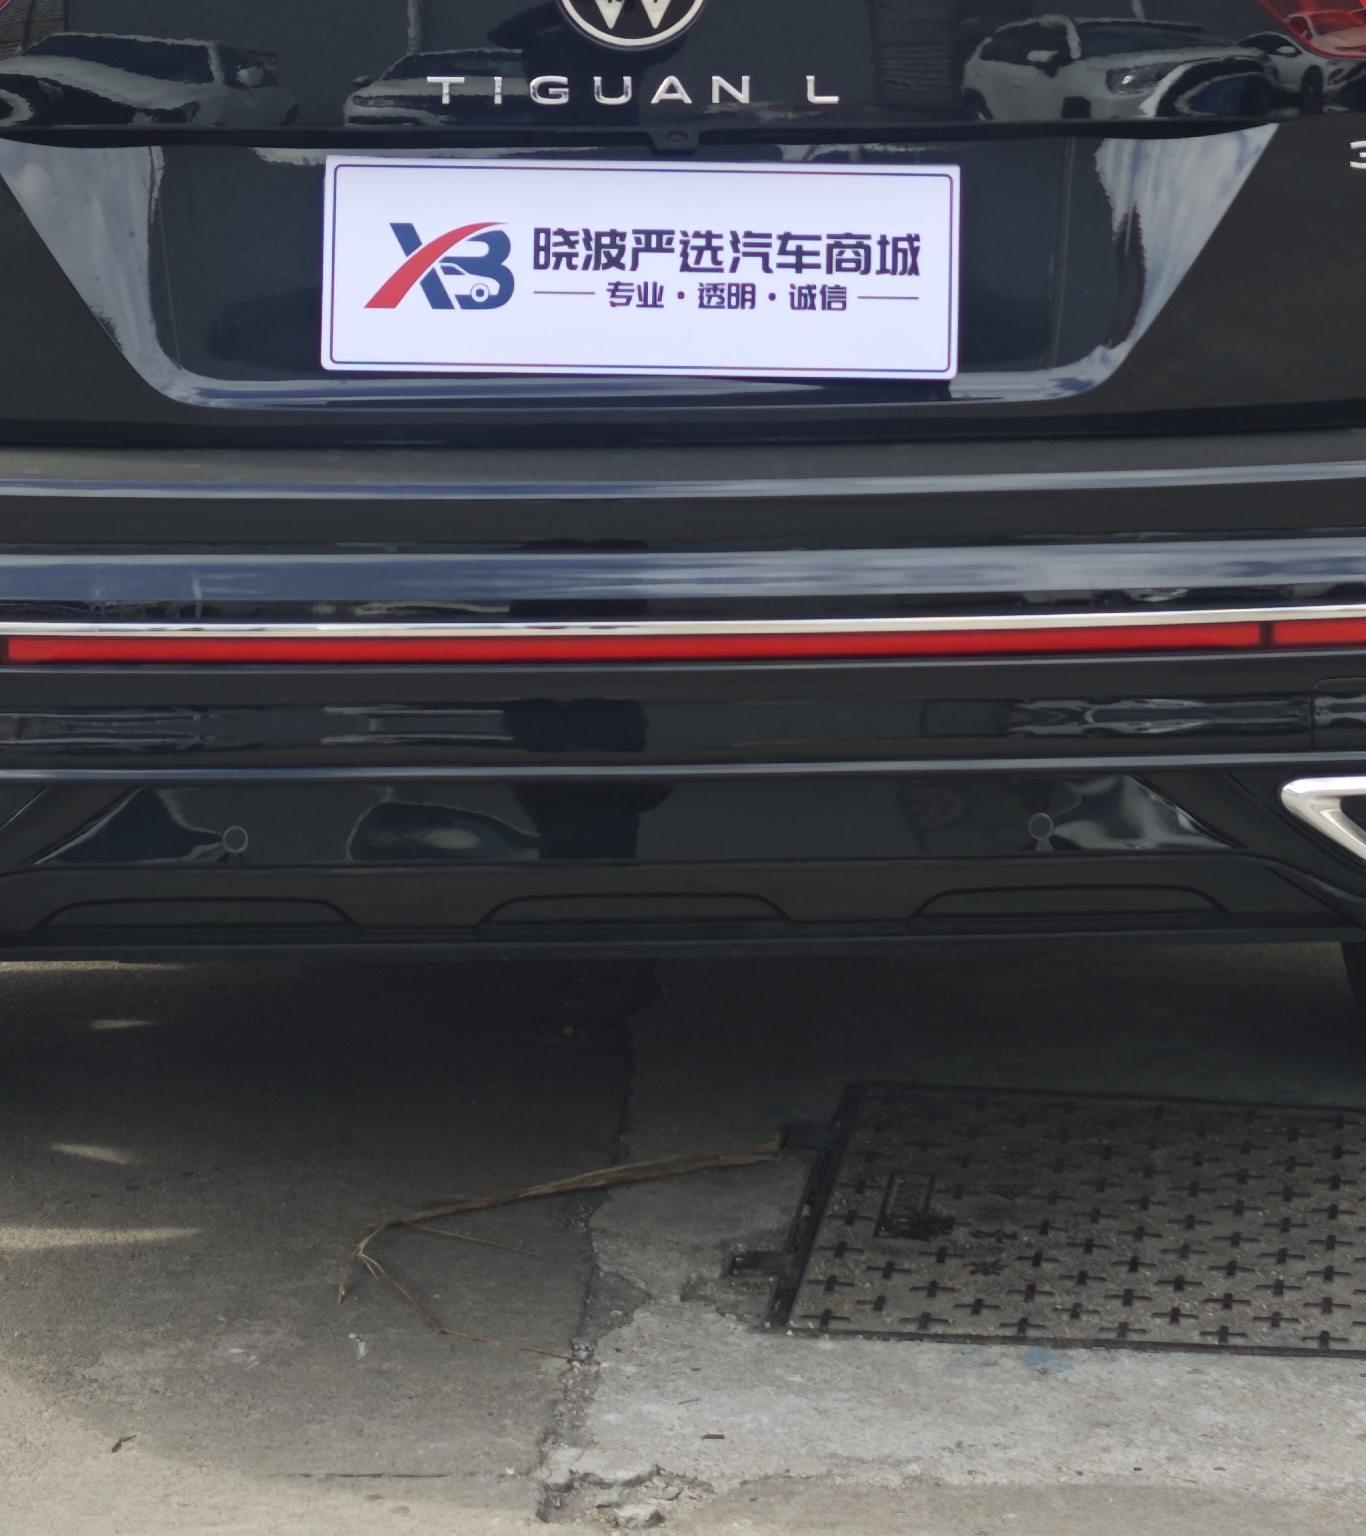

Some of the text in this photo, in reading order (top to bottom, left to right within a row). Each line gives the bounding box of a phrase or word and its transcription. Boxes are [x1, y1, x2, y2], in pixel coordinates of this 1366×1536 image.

[426, 75, 840, 105] TIGUAN L
[533, 227, 921, 276] 晓波严选汽车商城
